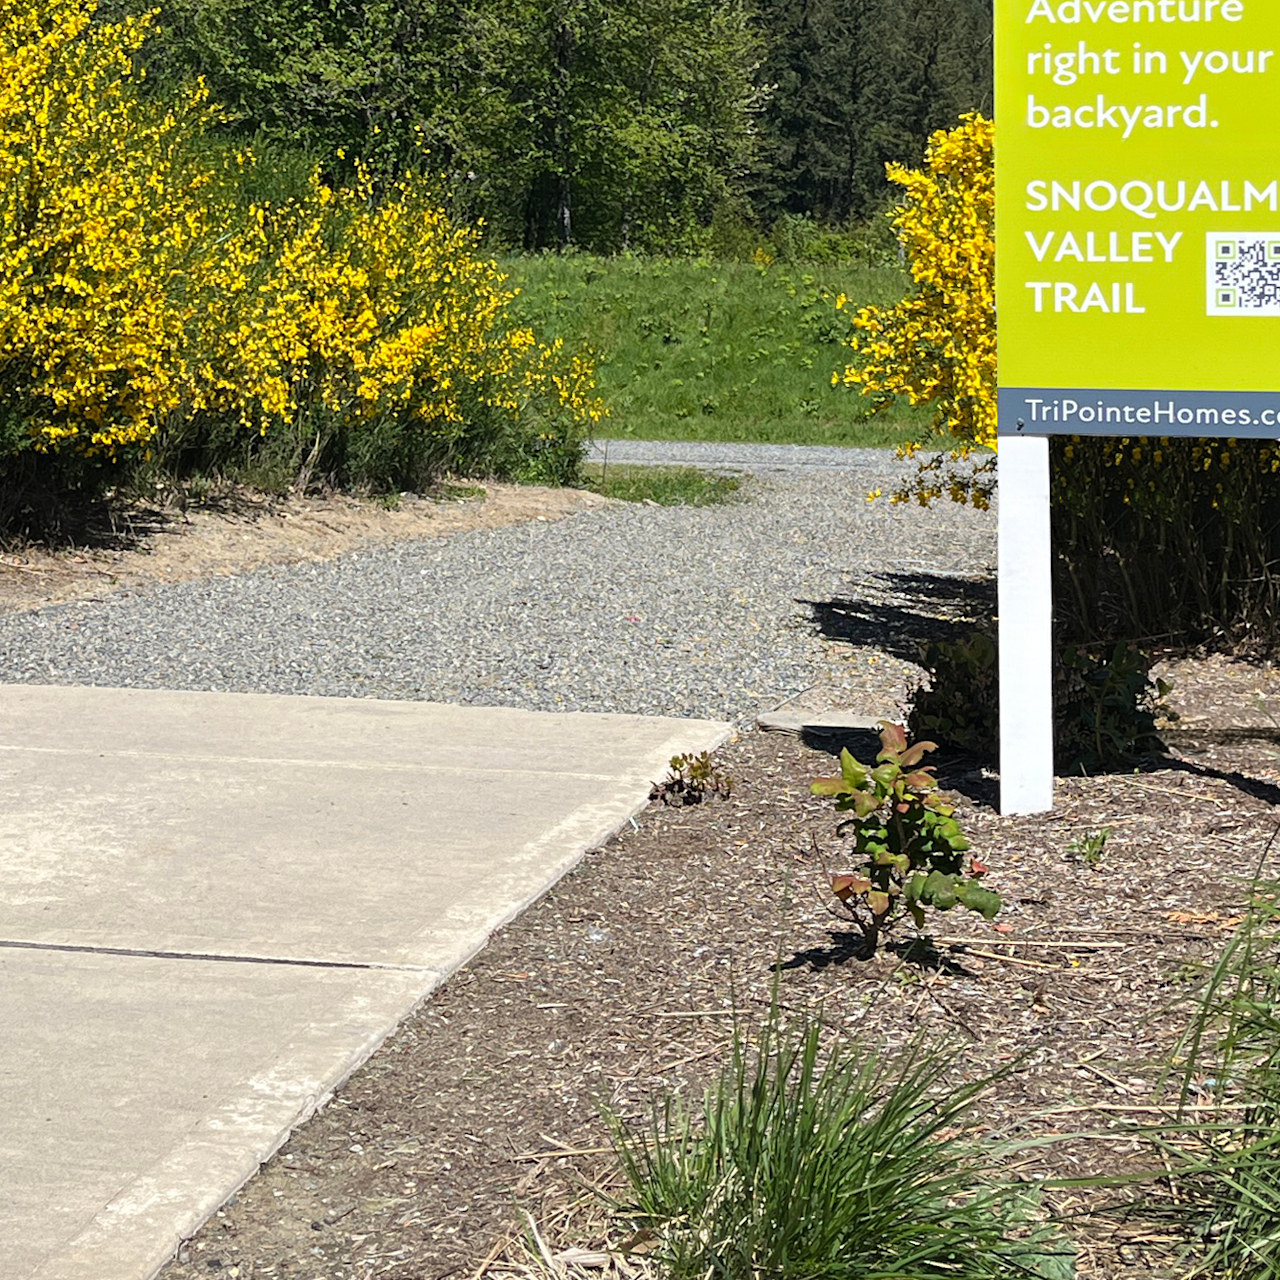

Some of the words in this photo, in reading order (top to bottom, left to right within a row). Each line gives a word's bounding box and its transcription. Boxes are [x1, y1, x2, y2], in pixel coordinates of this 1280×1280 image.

[1026, 41, 1120, 86] right
[1132, 41, 1167, 75] in
[1179, 49, 1274, 85] your
[1026, 93, 1220, 140] backyard.
[1024, 231, 1183, 263] VALLEY
[1025, 281, 1146, 313] TRAIL
